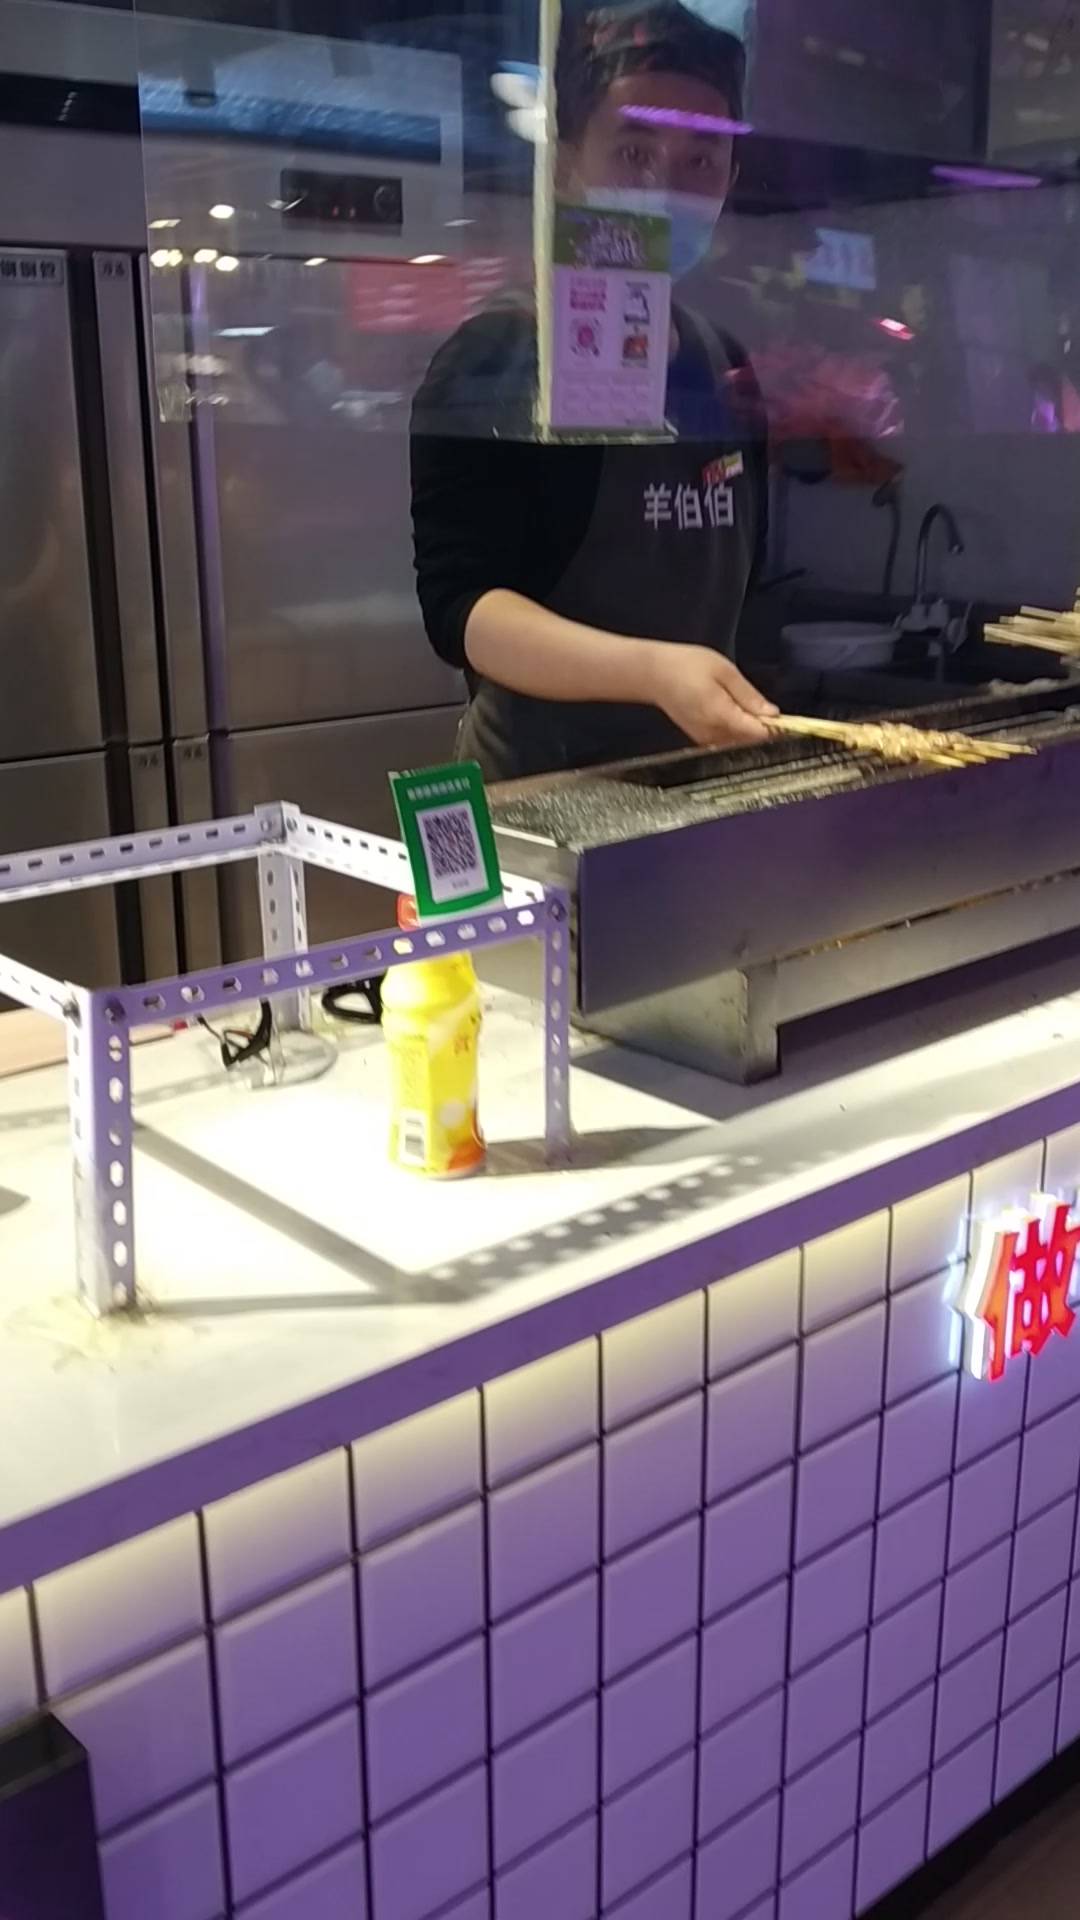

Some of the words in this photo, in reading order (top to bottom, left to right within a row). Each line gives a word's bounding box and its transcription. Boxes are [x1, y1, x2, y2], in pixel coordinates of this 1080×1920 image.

[643, 482, 734, 530] 羊伯伯
[980, 1203, 1080, 1381] 做
